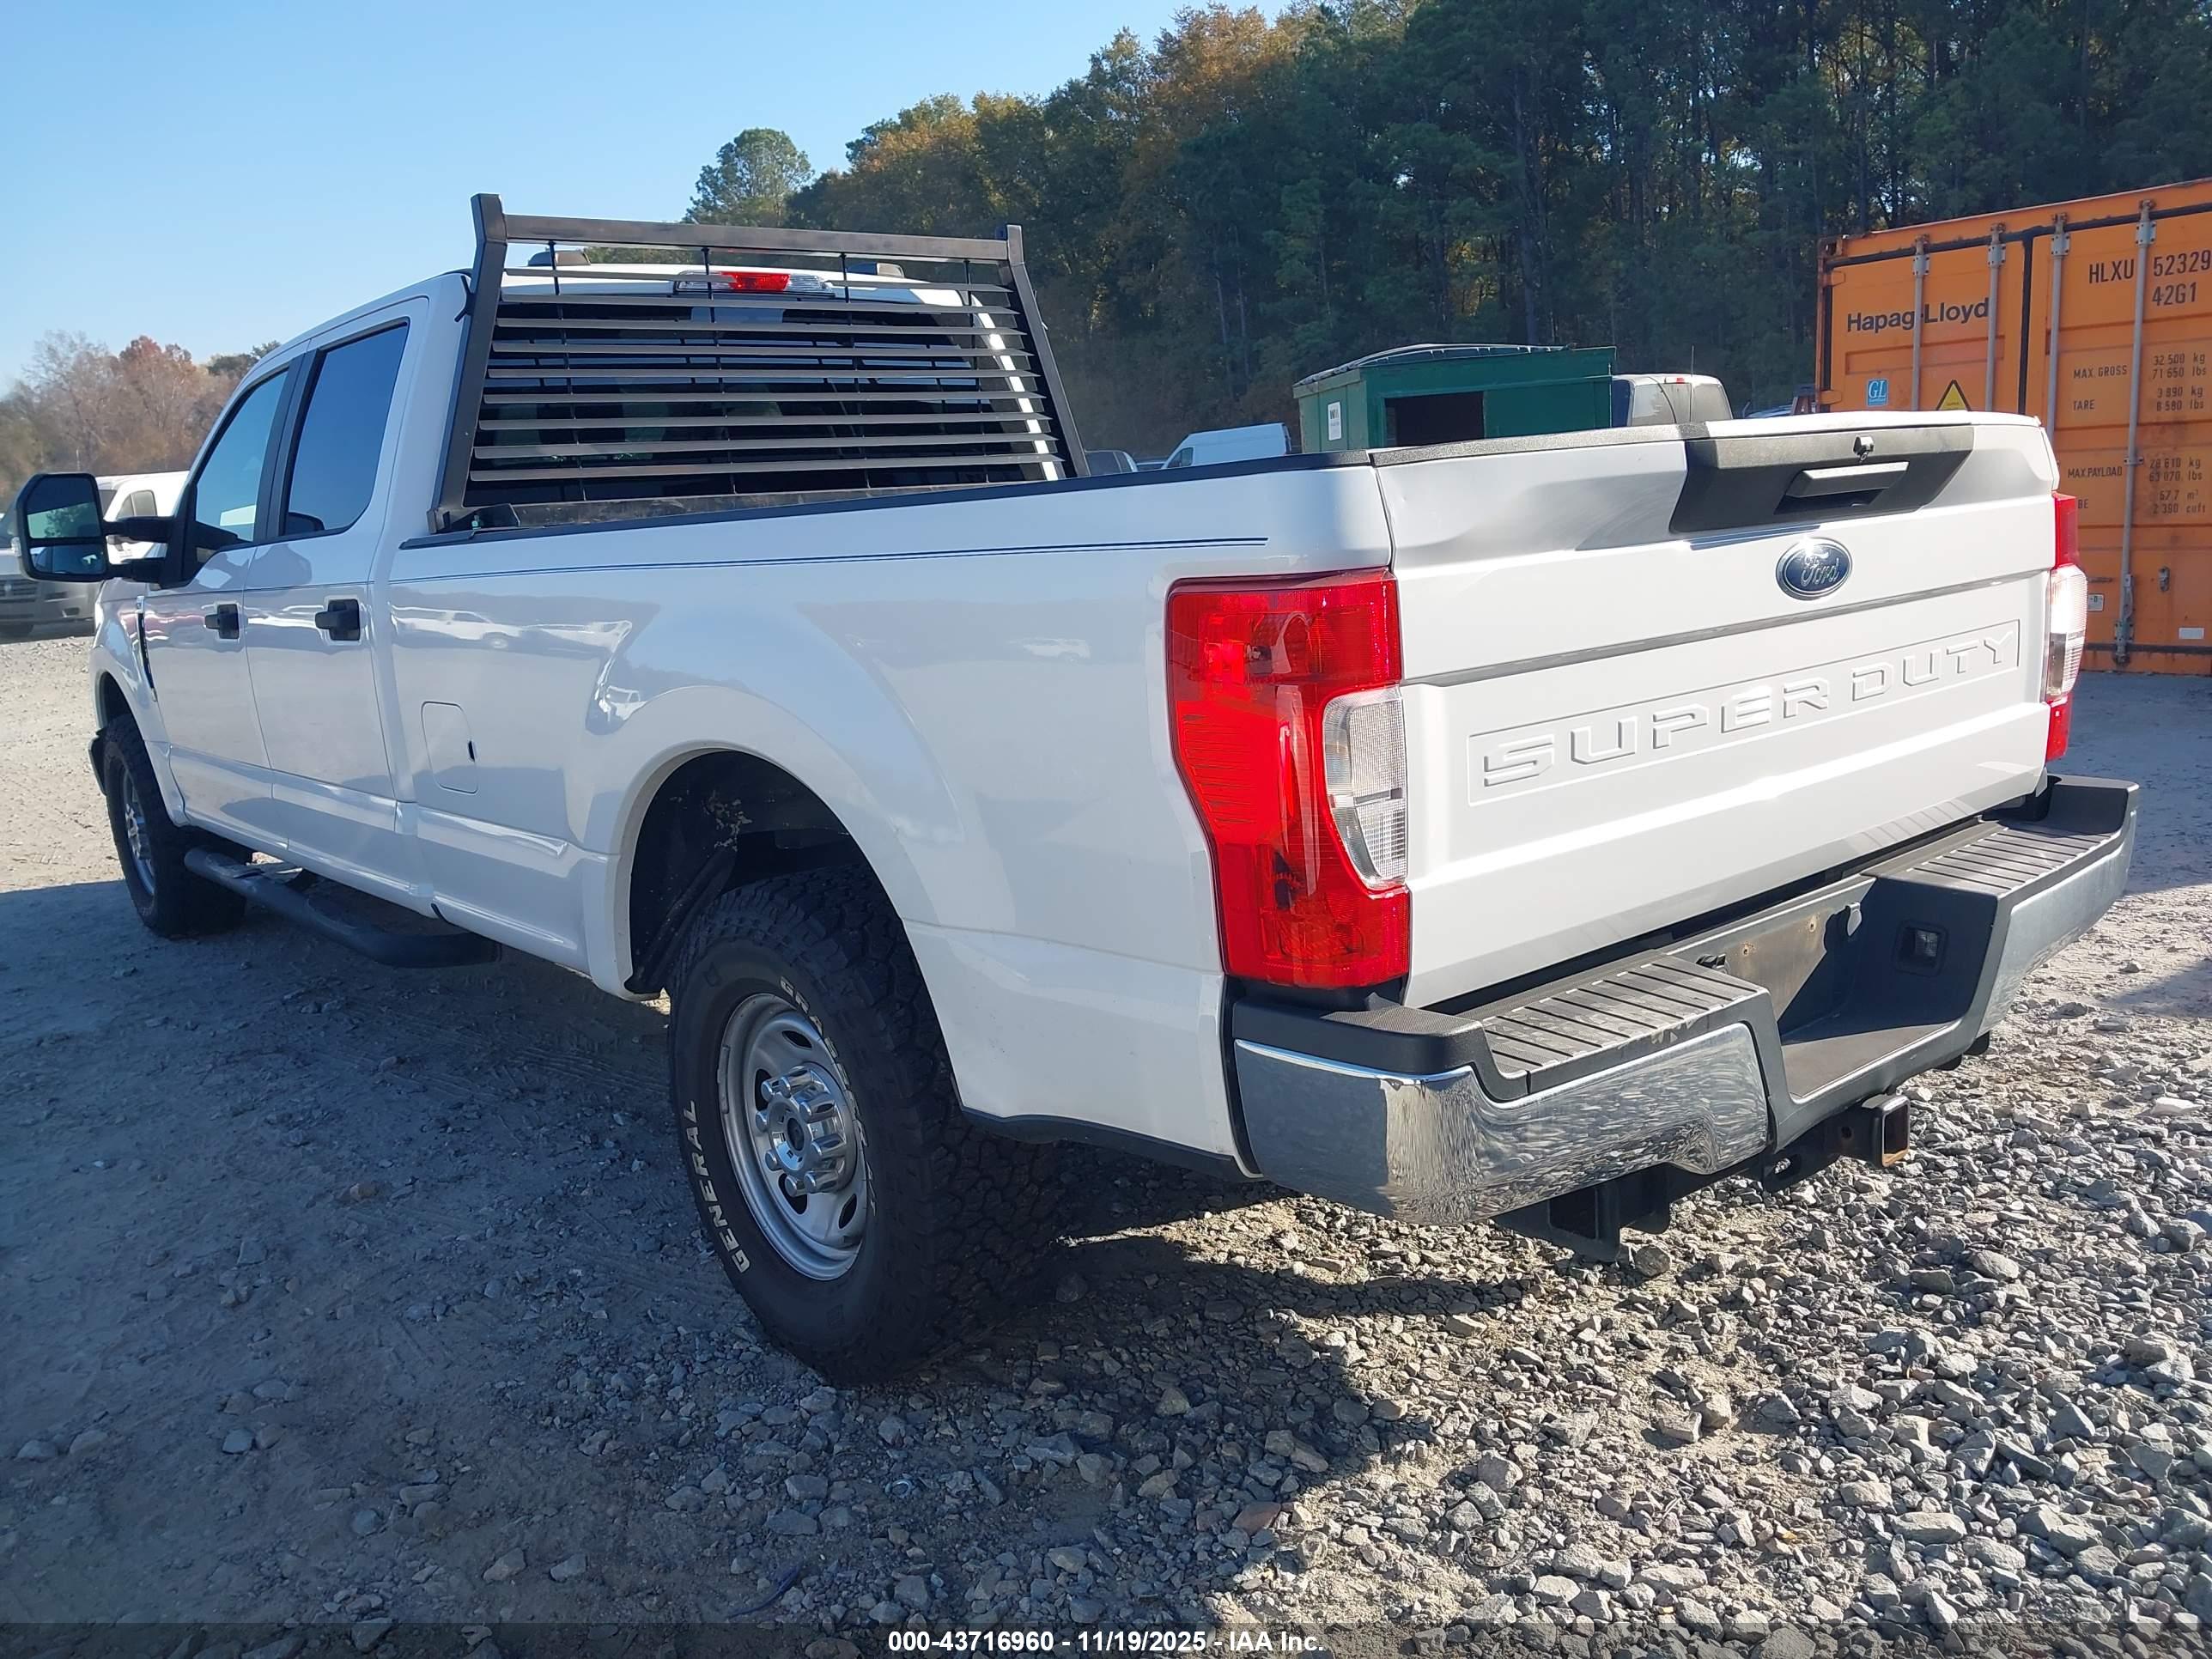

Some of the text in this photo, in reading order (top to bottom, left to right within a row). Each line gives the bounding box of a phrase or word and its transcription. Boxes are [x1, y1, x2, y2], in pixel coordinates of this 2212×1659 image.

[2088, 249, 2212, 284] HLXU 52329
[2152, 282, 2197, 307] 42G1
[2193, 352, 2206, 365] kg
[2098, 365, 2128, 377] GROSS
[2191, 366, 2207, 377] lbs
[2191, 385, 2203, 398] kg
[2073, 398, 2095, 411] TARE
[2189, 456, 2201, 470] kg
[2077, 498, 2089, 509] BE
[1483, 629, 2014, 787] SUPER DUTY
[684, 1099, 751, 1274] GENERAL
